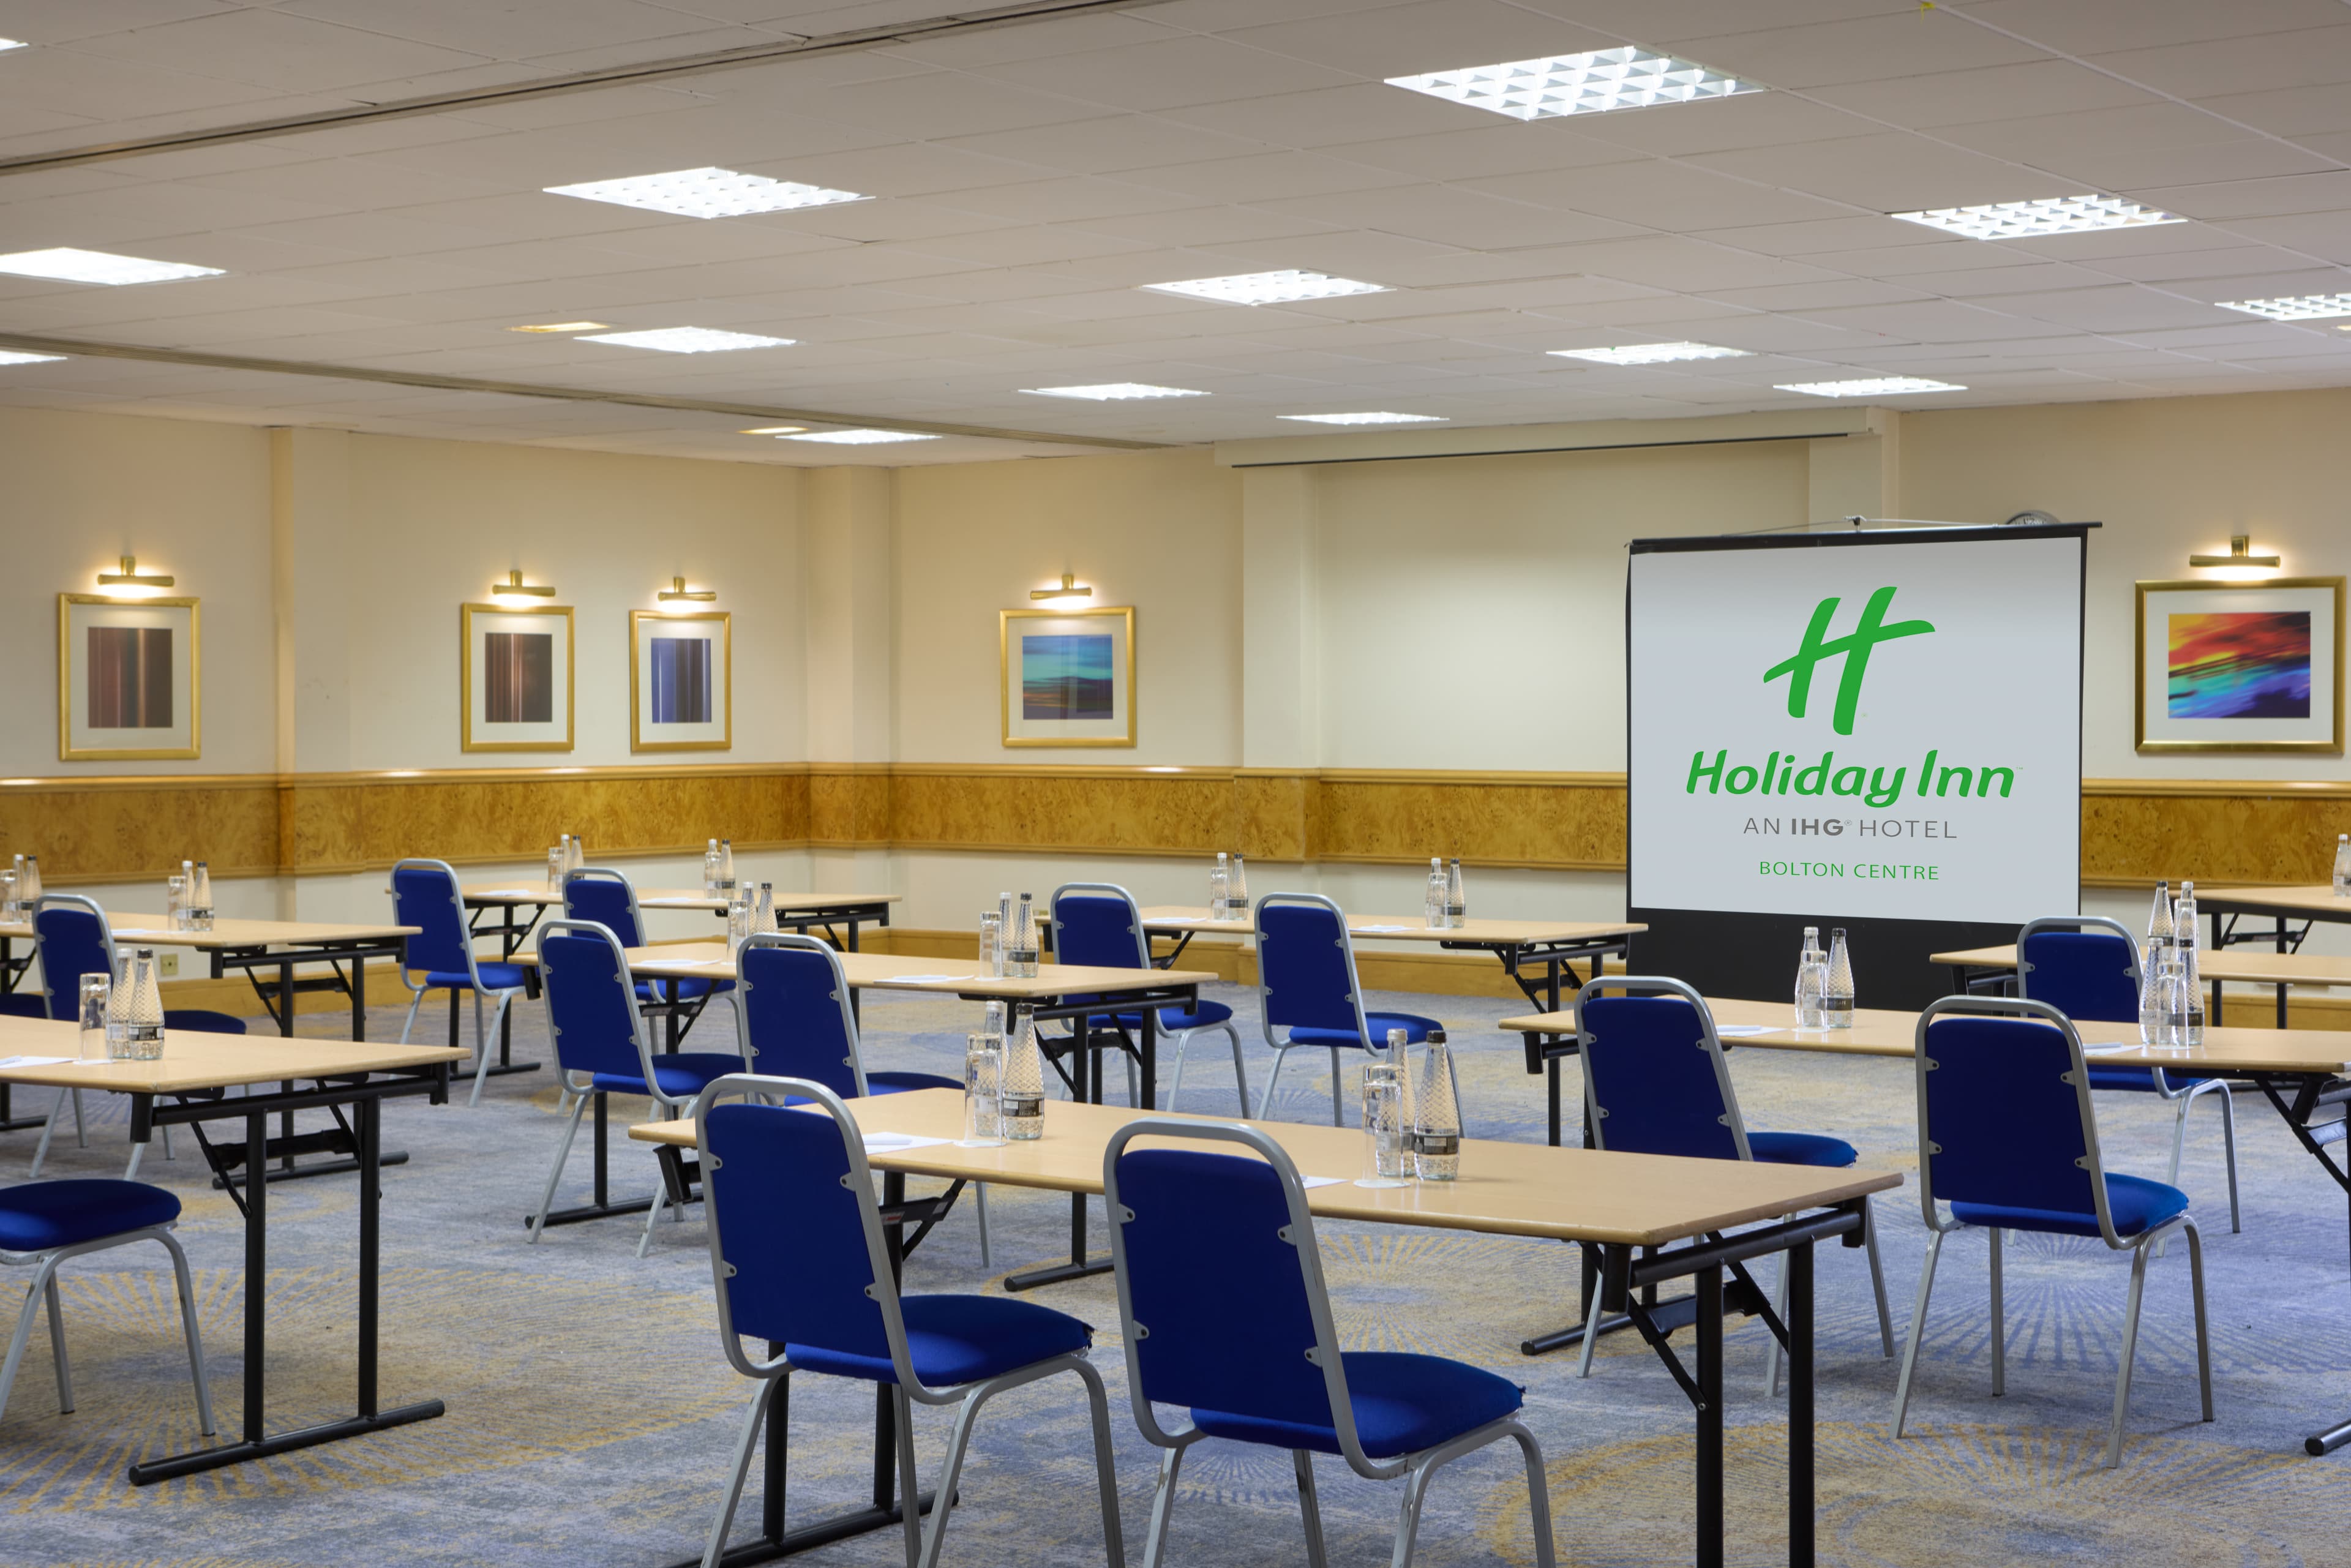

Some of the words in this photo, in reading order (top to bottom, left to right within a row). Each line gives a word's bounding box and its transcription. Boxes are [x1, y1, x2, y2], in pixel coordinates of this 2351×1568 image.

[1686, 749, 1907, 808] Holiday
[1917, 749, 2014, 798] Inn
[1743, 817, 1780, 835] AN
[1860, 819, 1957, 838] HOTEL
[1760, 861, 1844, 877] BOLTON
[1853, 863, 1940, 880] CENTRE
